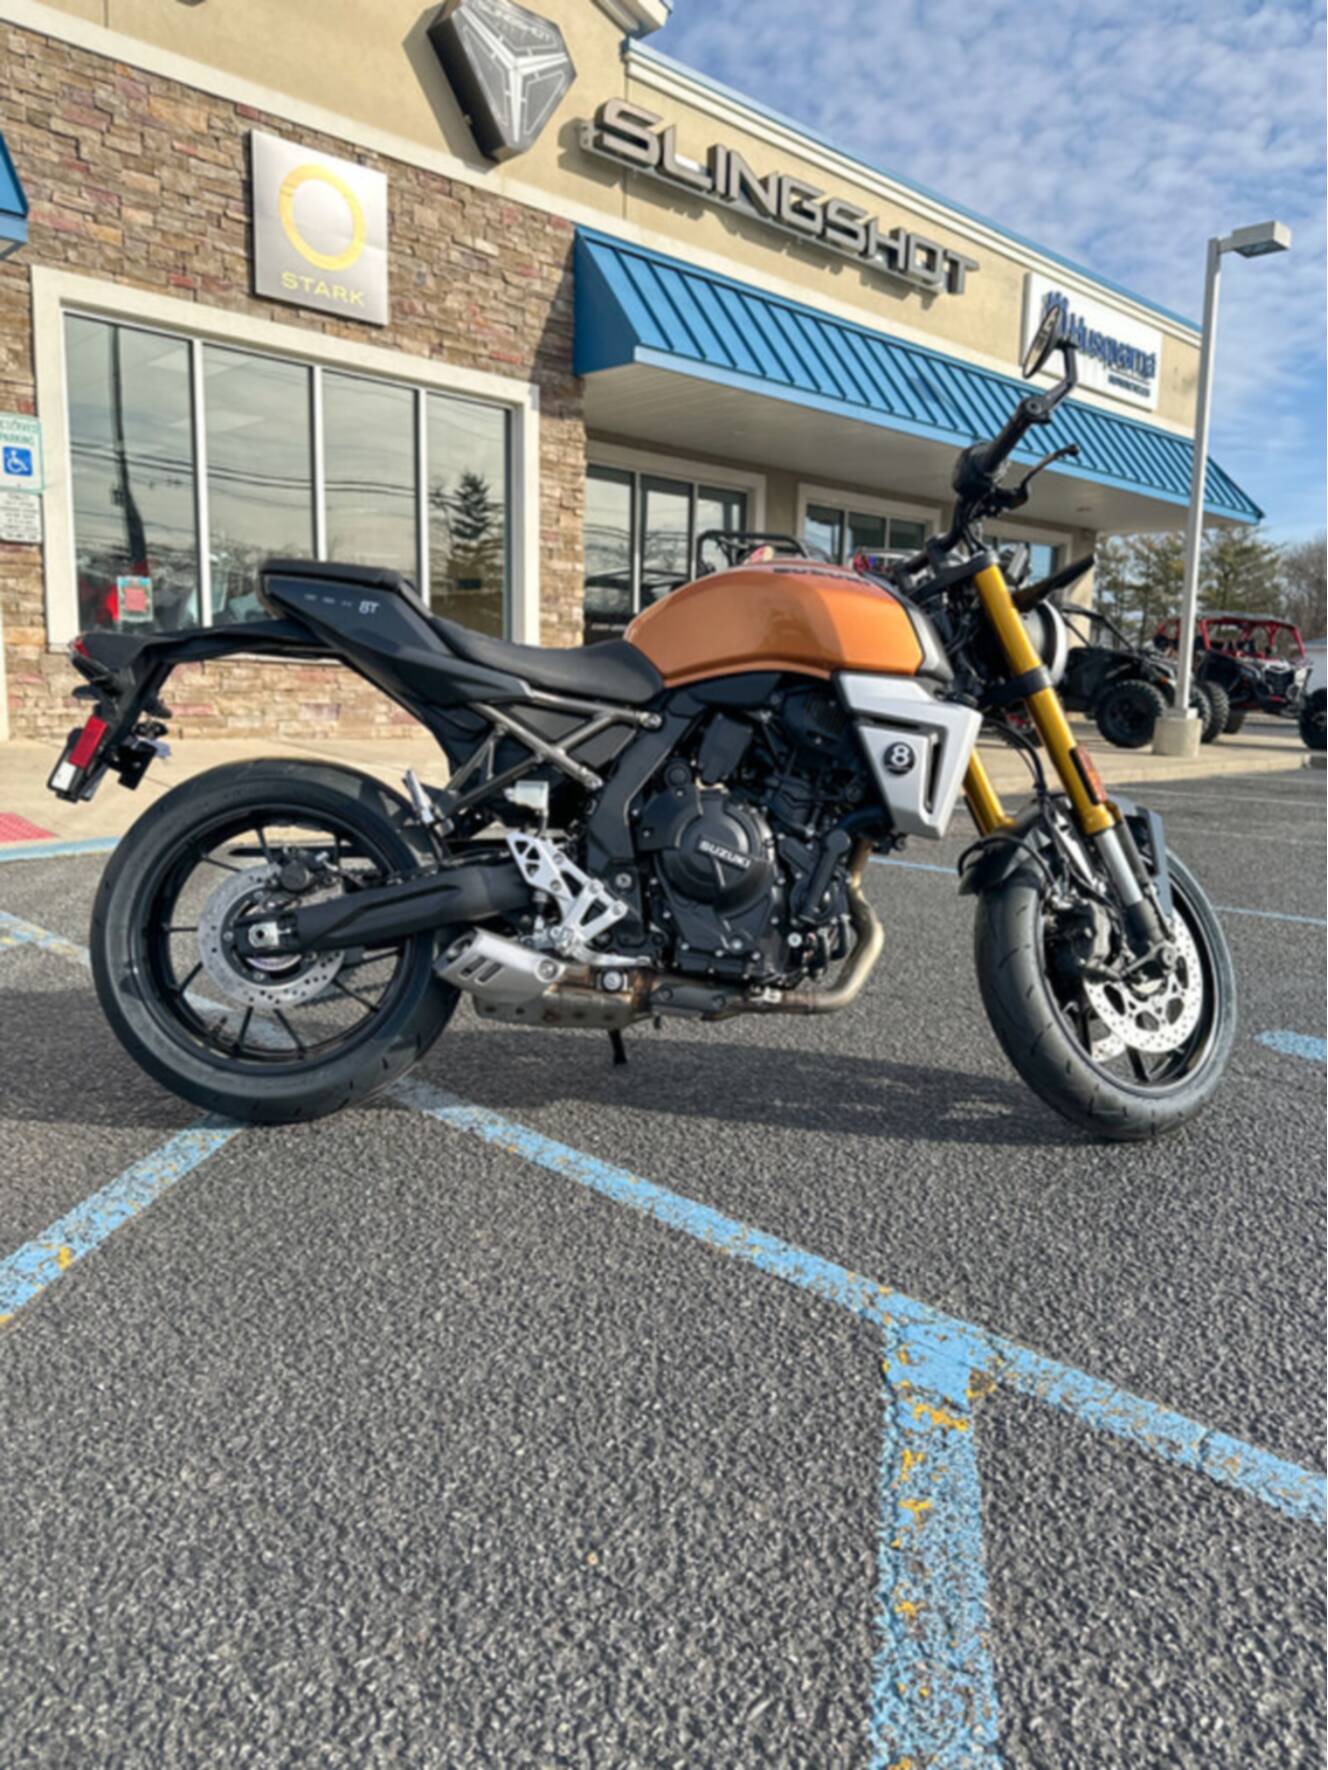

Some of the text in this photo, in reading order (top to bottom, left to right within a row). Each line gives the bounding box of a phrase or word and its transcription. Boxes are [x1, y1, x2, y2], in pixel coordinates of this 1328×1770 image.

[594, 97, 980, 295] SLINGSHOT
[280, 271, 366, 306] STARK
[890, 744, 910, 767] 8
[699, 840, 751, 869] SUZUKI
